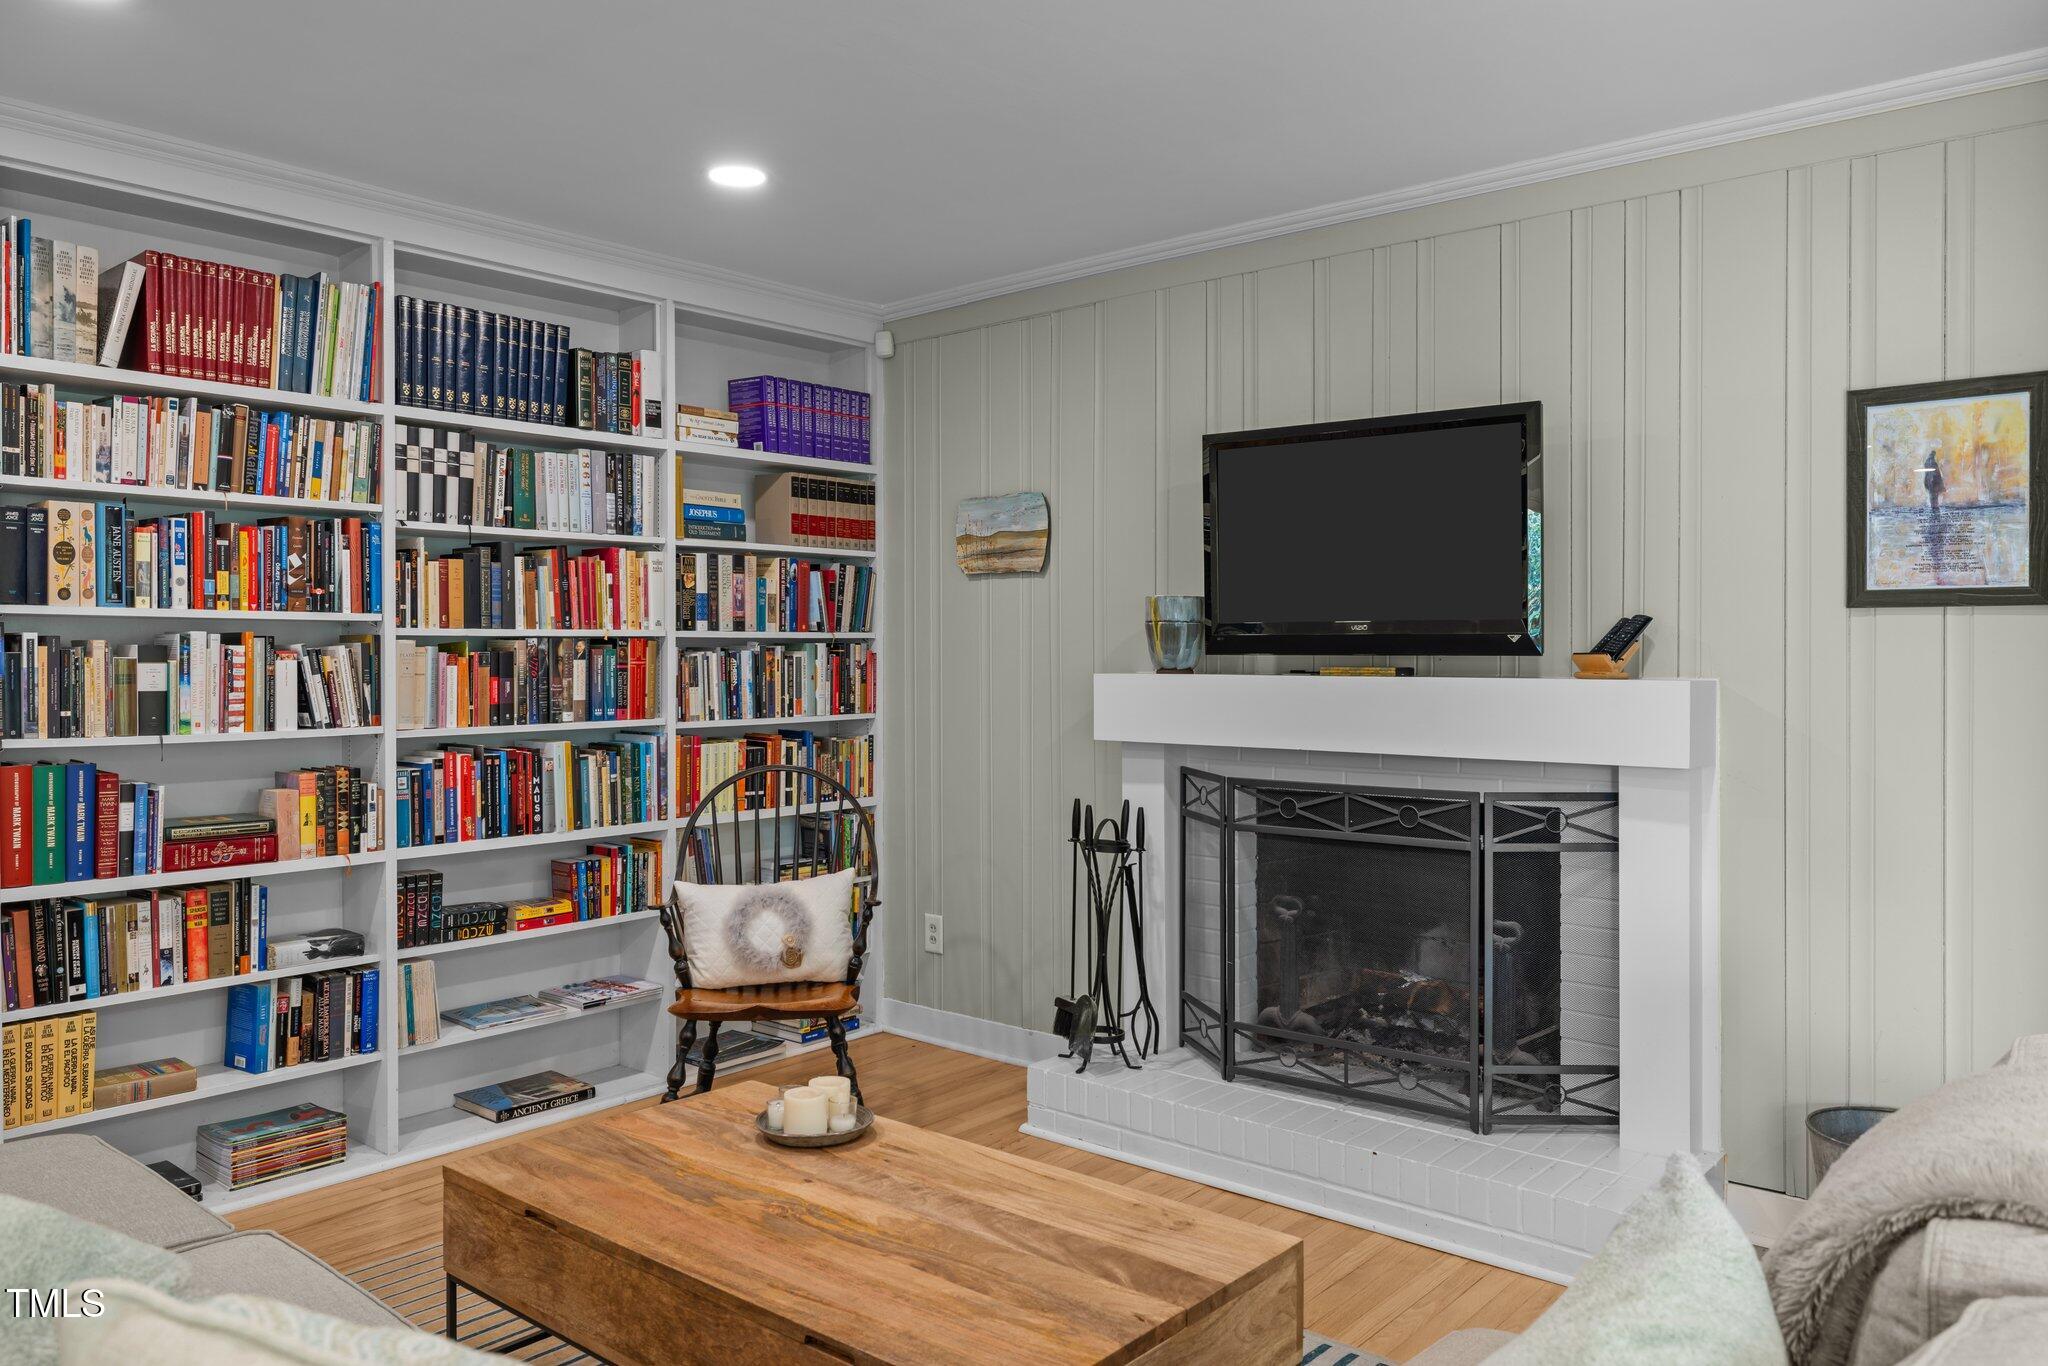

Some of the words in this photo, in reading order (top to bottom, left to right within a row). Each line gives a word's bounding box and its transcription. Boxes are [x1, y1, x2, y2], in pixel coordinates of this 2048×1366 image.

[152, 256, 158, 264] 1
[166, 259, 174, 268] 2
[182, 262, 189, 270] 3
[194, 264, 202, 273] 4
[207, 266, 215, 275] 5
[223, 269, 231, 278] 6
[238, 272, 244, 280] 7
[252, 275, 259, 283] 8
[265, 277, 272, 285] 9
[245, 455, 258, 486] kafka
[582, 452, 590, 487] 1861
[688, 508, 718, 519] JOSEPHUS
[111, 526, 122, 547] JANE
[112, 549, 122, 582] AUSTEN
[12, 807, 21, 827] MARK
[47, 806, 56, 825] MARK
[77, 802, 85, 822] MARK
[12, 827, 21, 849] TWAIN
[47, 826, 56, 848] TWAIN
[77, 822, 85, 842] TWAIN
[189, 906, 207, 914] SPANISH
[83, 1026, 90, 1035] LA
[46, 1043, 54, 1054] LA
[64, 1039, 71, 1049] EN
[71, 1038, 78, 1047] LA
[82, 1035, 90, 1061] GUERRA
[2, 1049, 10, 1058] EN
[9, 1048, 16, 1058] LA
[25, 1041, 33, 1073] BUQUES
[70, 1048, 78, 1075] GUERRA
[9, 1058, 17, 1085] GUERRA
[46, 1054, 54, 1081] GUERRA
[81, 1062, 89, 1099] SUBMARINA
[25, 1075, 33, 1110] SUICIDAS
[512, 1102, 549, 1119] ANCIENT
[550, 1094, 579, 1110] GREECE
